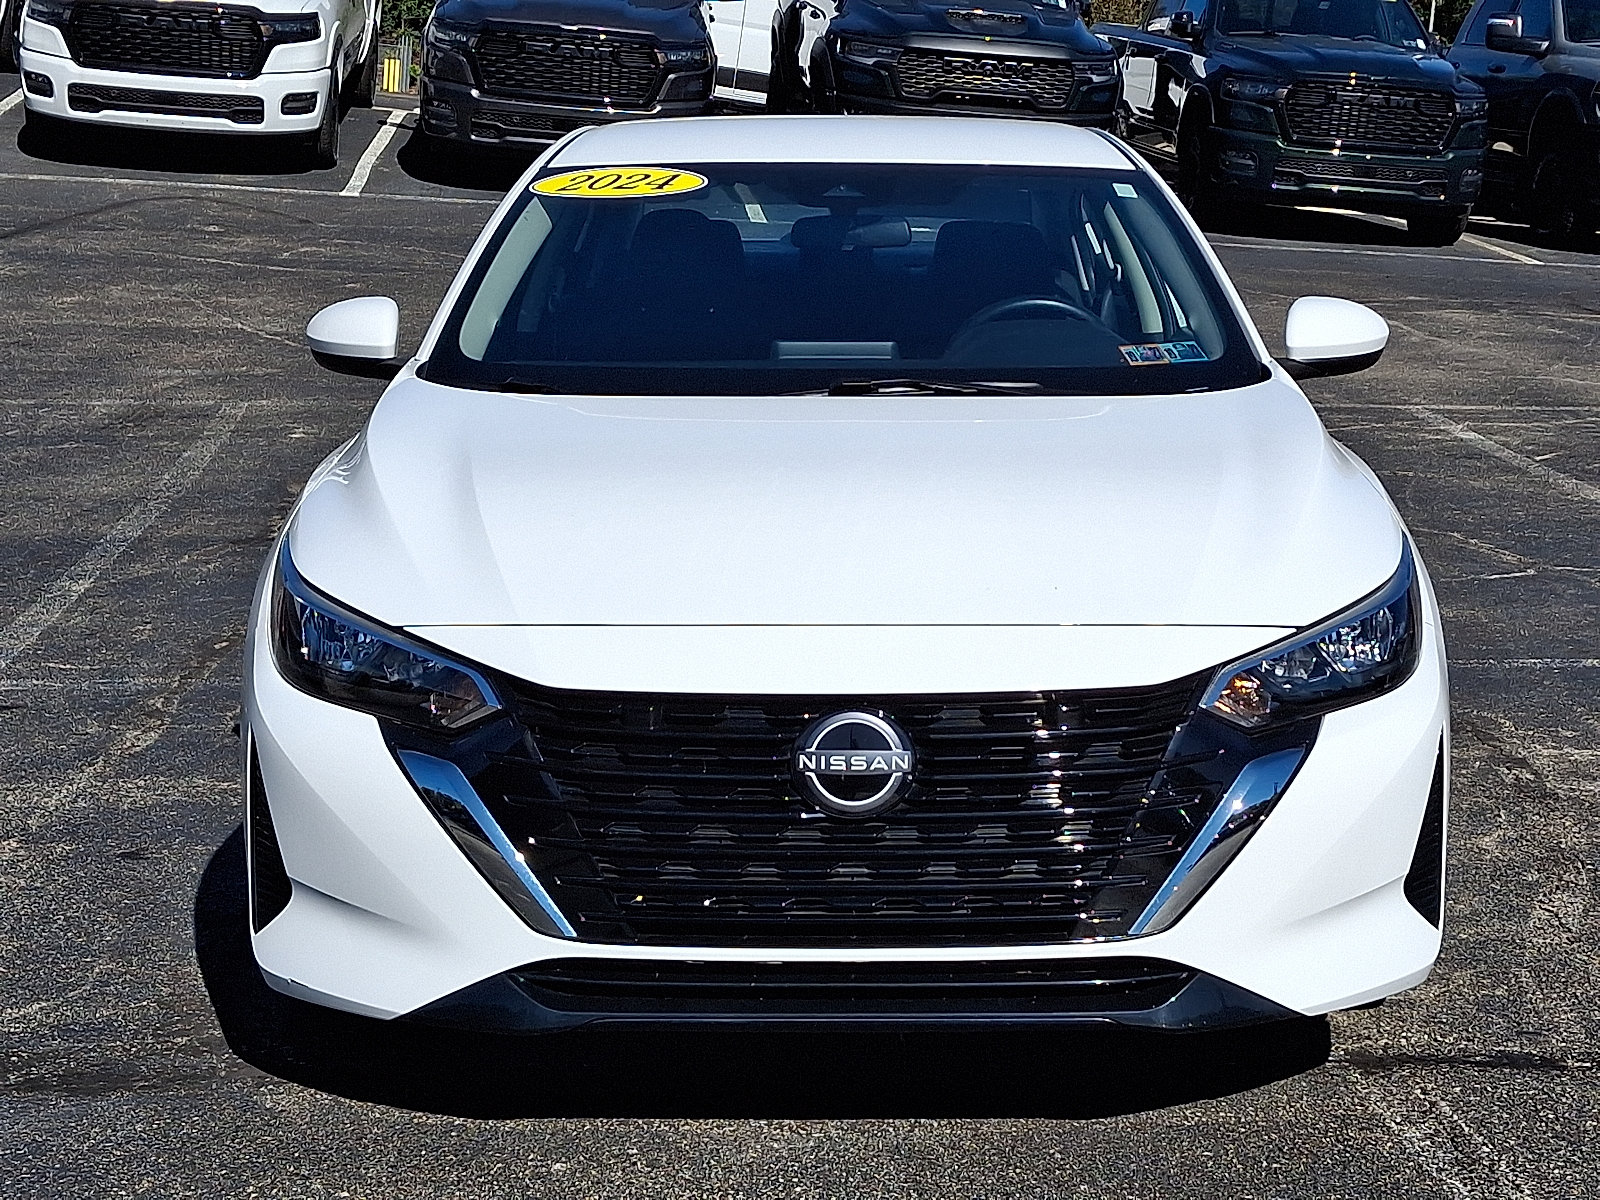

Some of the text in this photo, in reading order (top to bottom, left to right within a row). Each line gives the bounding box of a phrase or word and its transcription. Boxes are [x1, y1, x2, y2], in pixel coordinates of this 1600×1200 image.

[943, 57, 1034, 77] RAM
[555, 173, 682, 192] 2024
[799, 755, 909, 770] NISSAN
